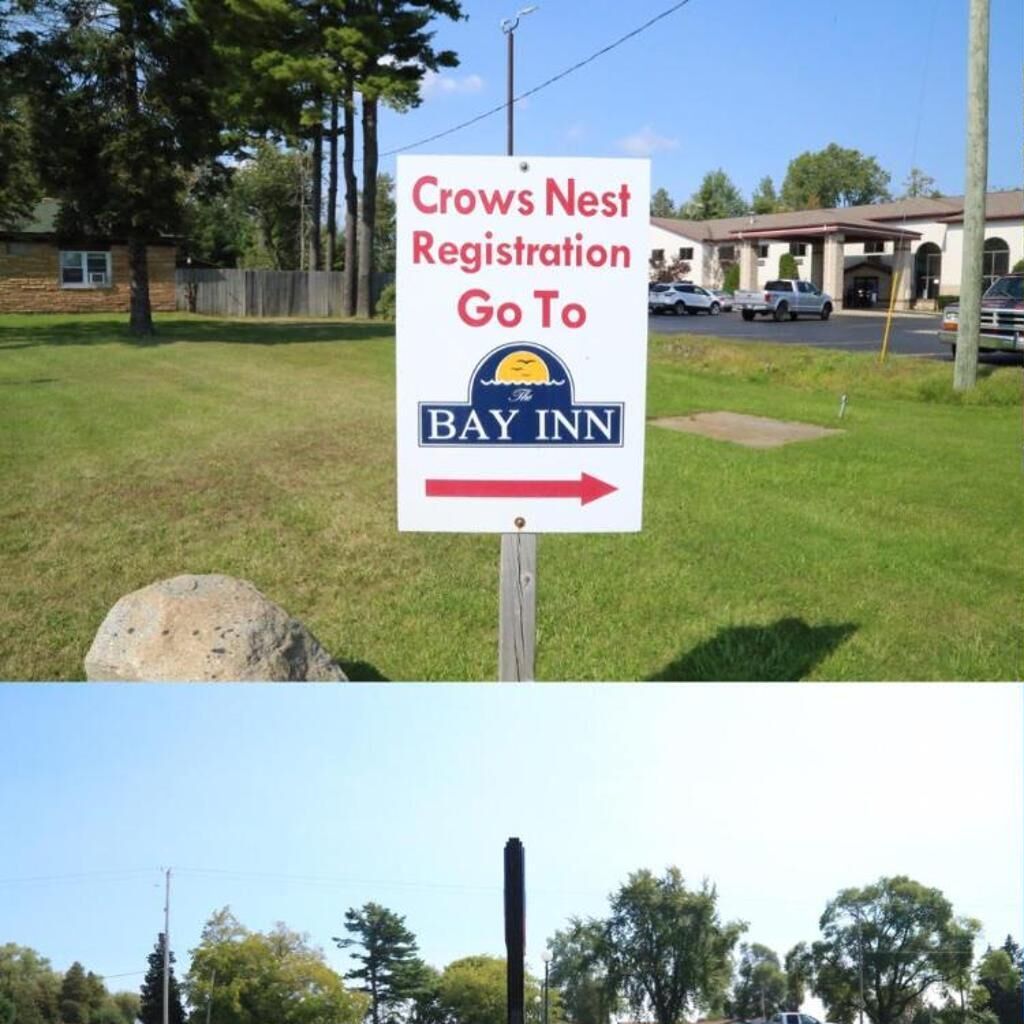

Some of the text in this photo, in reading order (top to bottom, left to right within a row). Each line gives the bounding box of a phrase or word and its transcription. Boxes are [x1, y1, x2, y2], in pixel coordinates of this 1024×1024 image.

[412, 175, 631, 218] Crows Nest
[412, 231, 631, 274] Registration
[457, 288, 586, 329] Go To
[508, 388, 533, 402] The
[427, 409, 616, 441] BAY INN
